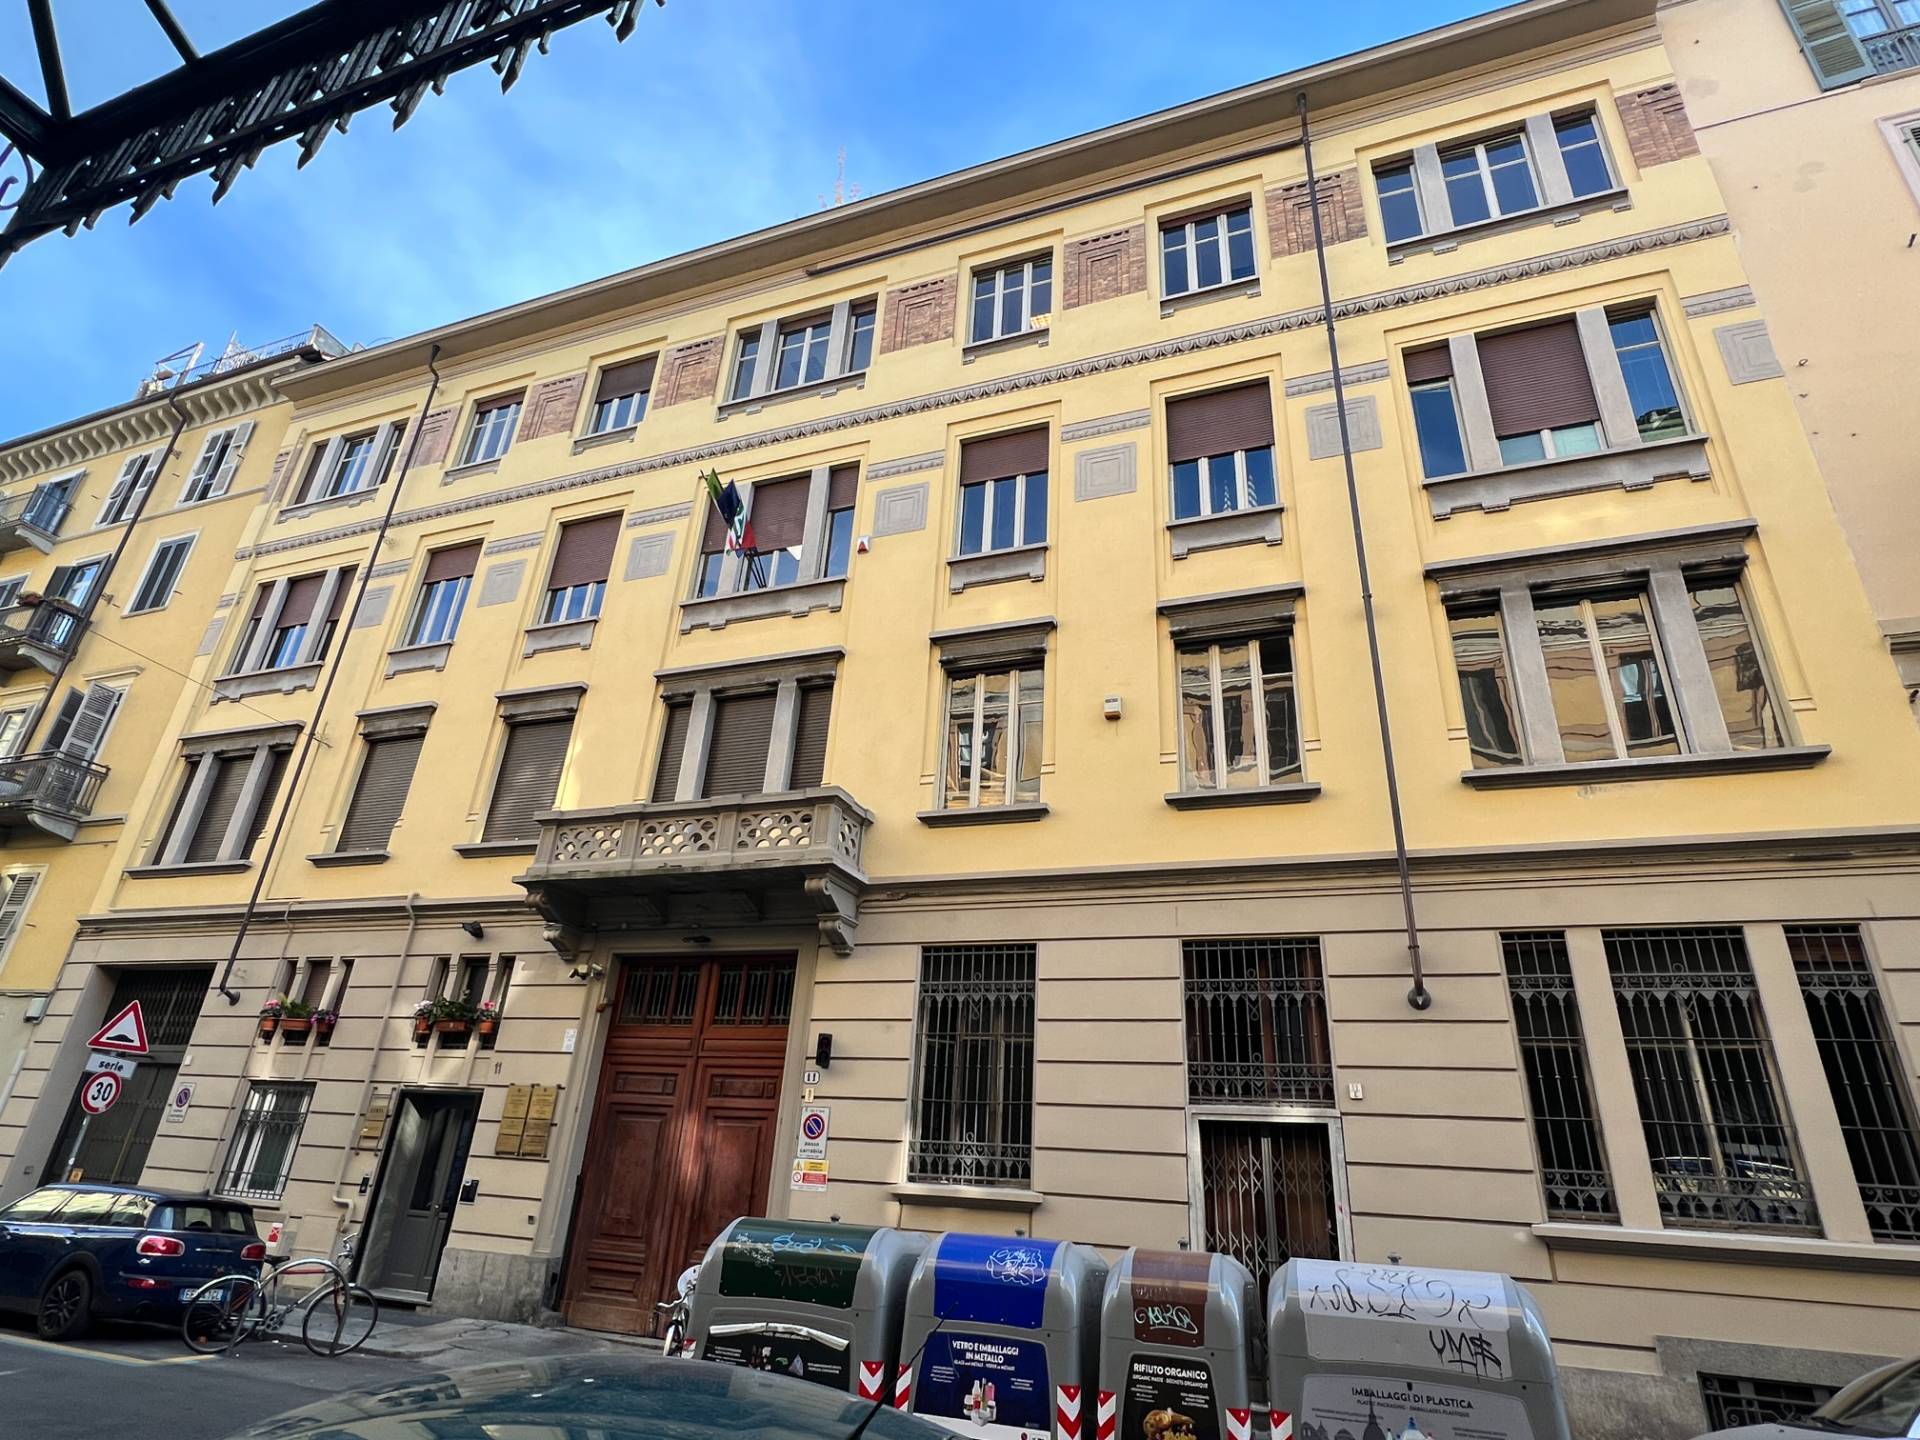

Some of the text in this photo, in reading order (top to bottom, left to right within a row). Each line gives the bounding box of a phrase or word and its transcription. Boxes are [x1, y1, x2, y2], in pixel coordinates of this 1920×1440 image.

[98, 1060, 124, 1072] serie
[807, 1072, 816, 1082] 11
[91, 1081, 113, 1101] 30
[952, 1340, 1019, 1356] VETRO E IMBALLAGGI
[965, 1351, 1004, 1364] IN METALLO
[1133, 1363, 1207, 1381] RIFIUTO ORGANICO
[1351, 1387, 1474, 1410] IMBALLAGGI DI PLASTICA
